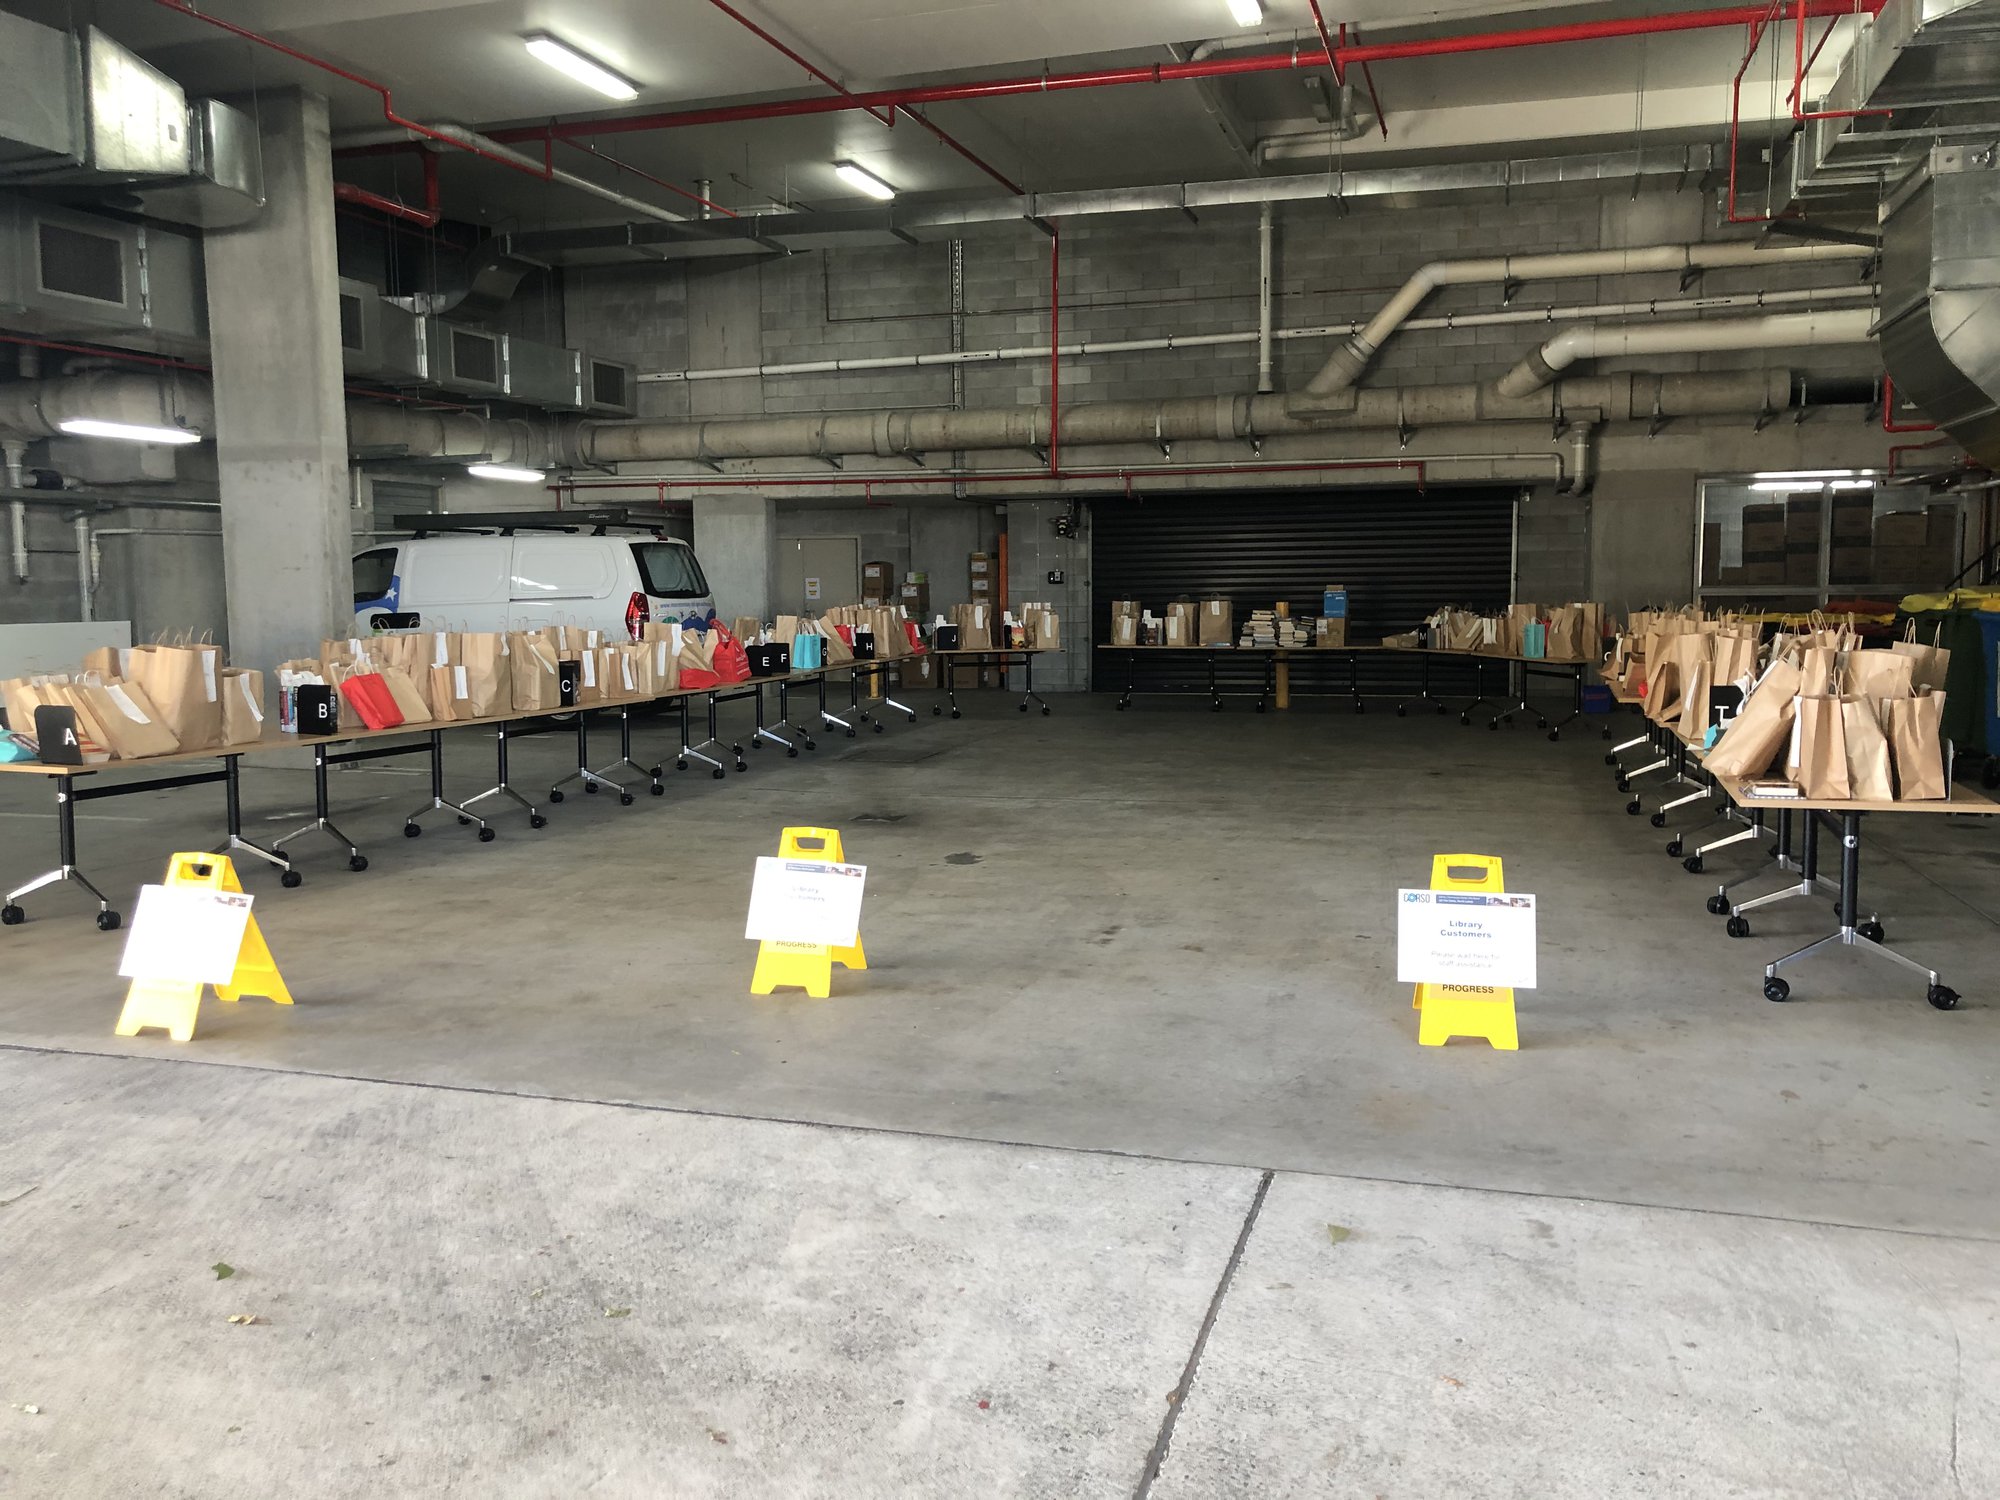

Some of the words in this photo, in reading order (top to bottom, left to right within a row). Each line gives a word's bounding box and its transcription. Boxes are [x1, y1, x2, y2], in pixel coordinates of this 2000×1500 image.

[951, 634, 957, 643] J
[1419, 632, 1427, 641] M
[865, 642, 873, 651] H
[821, 647, 828, 657] G
[762, 656, 770, 667] E
[780, 653, 788, 663] F
[561, 679, 572, 693] C
[318, 703, 328, 719] B
[1714, 705, 1730, 729] T
[64, 727, 78, 746] A
[1403, 892, 1431, 904] CORSO
[1449, 920, 1483, 930] Library
[1440, 929, 1492, 939] Customers
[775, 940, 818, 950] PROGRESS
[1442, 983, 1495, 994] PROGRESS
